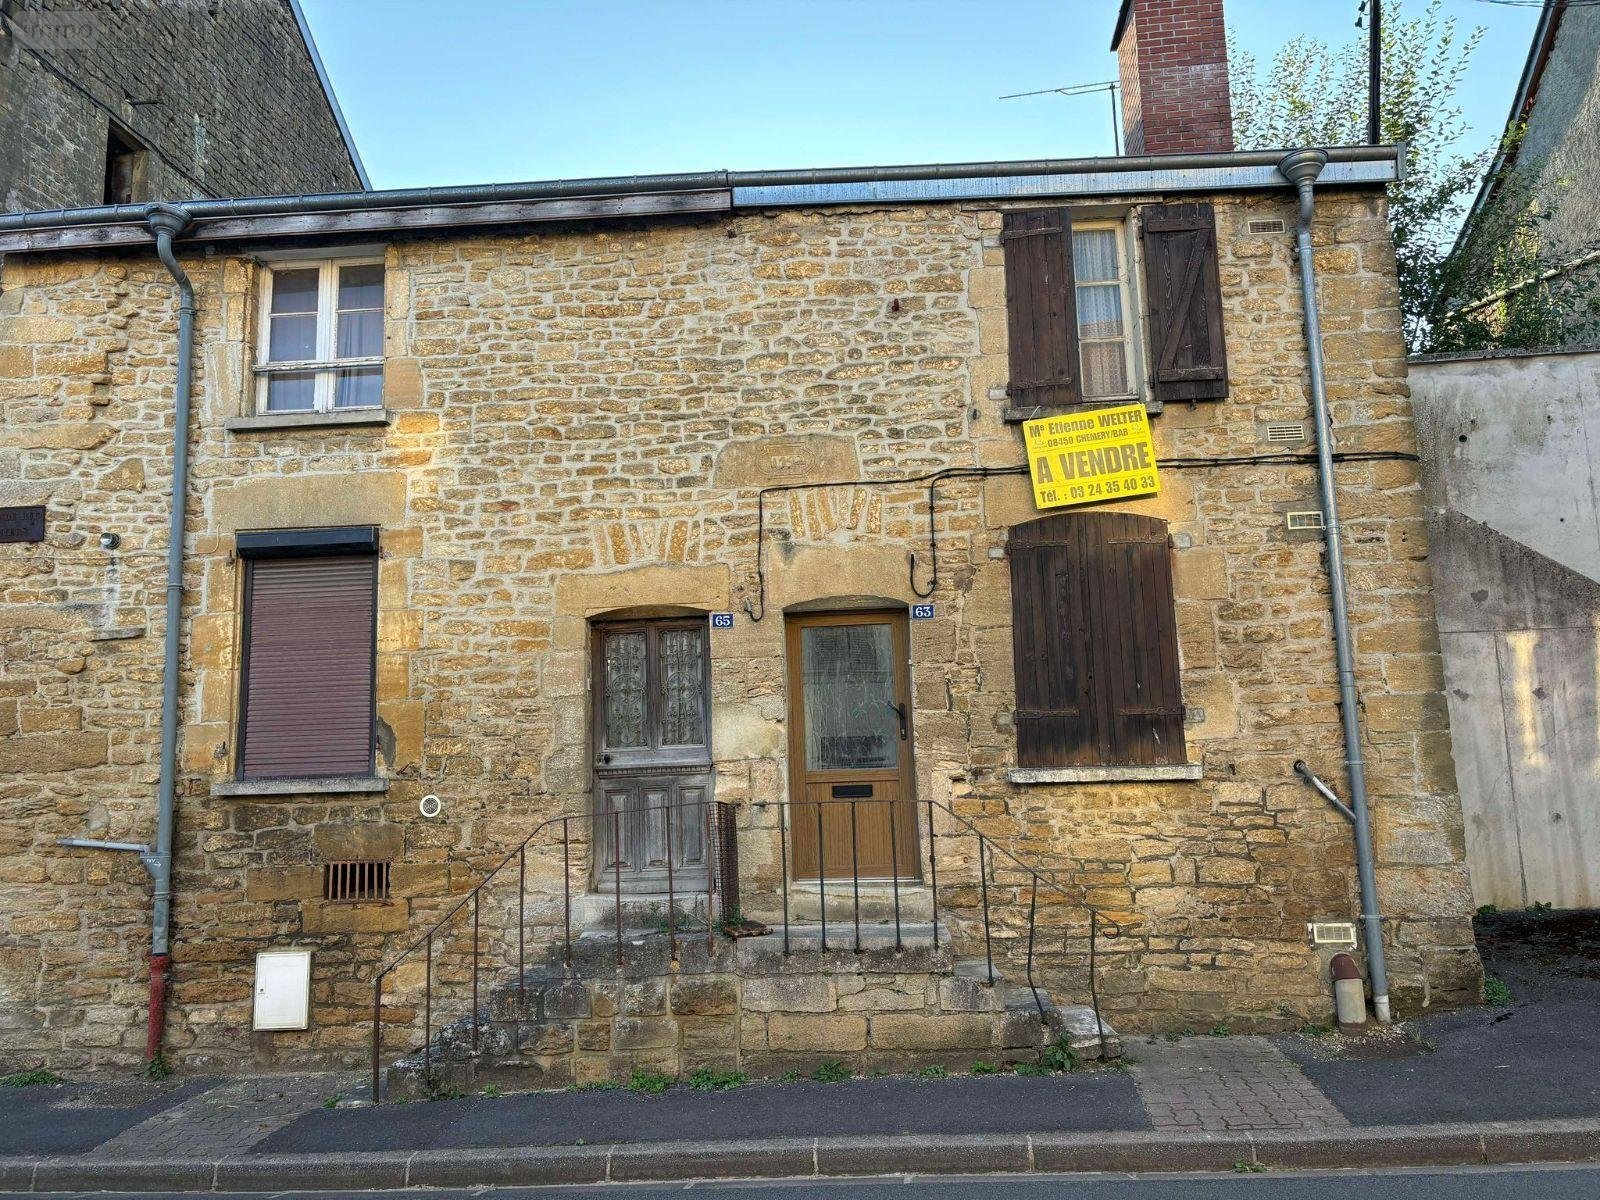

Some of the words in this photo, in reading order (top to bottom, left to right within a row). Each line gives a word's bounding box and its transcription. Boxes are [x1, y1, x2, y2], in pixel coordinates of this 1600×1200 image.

[1048, 418, 1095, 435] Etienne
[1097, 409, 1143, 427] WELTER
[1047, 436, 1074, 448] 08450
[1076, 428, 1129, 444] CHEMERY/BAR
[1036, 456, 1054, 484] A
[1059, 441, 1152, 480] VENDRE
[1070, 485, 1085, 499] 03
[1087, 483, 1103, 496] 24
[1105, 480, 1120, 494] 35
[1123, 478, 1137, 491] 40
[1141, 475, 1156, 488] 33
[715, 615, 731, 627] 65
[915, 606, 931, 617] 63
